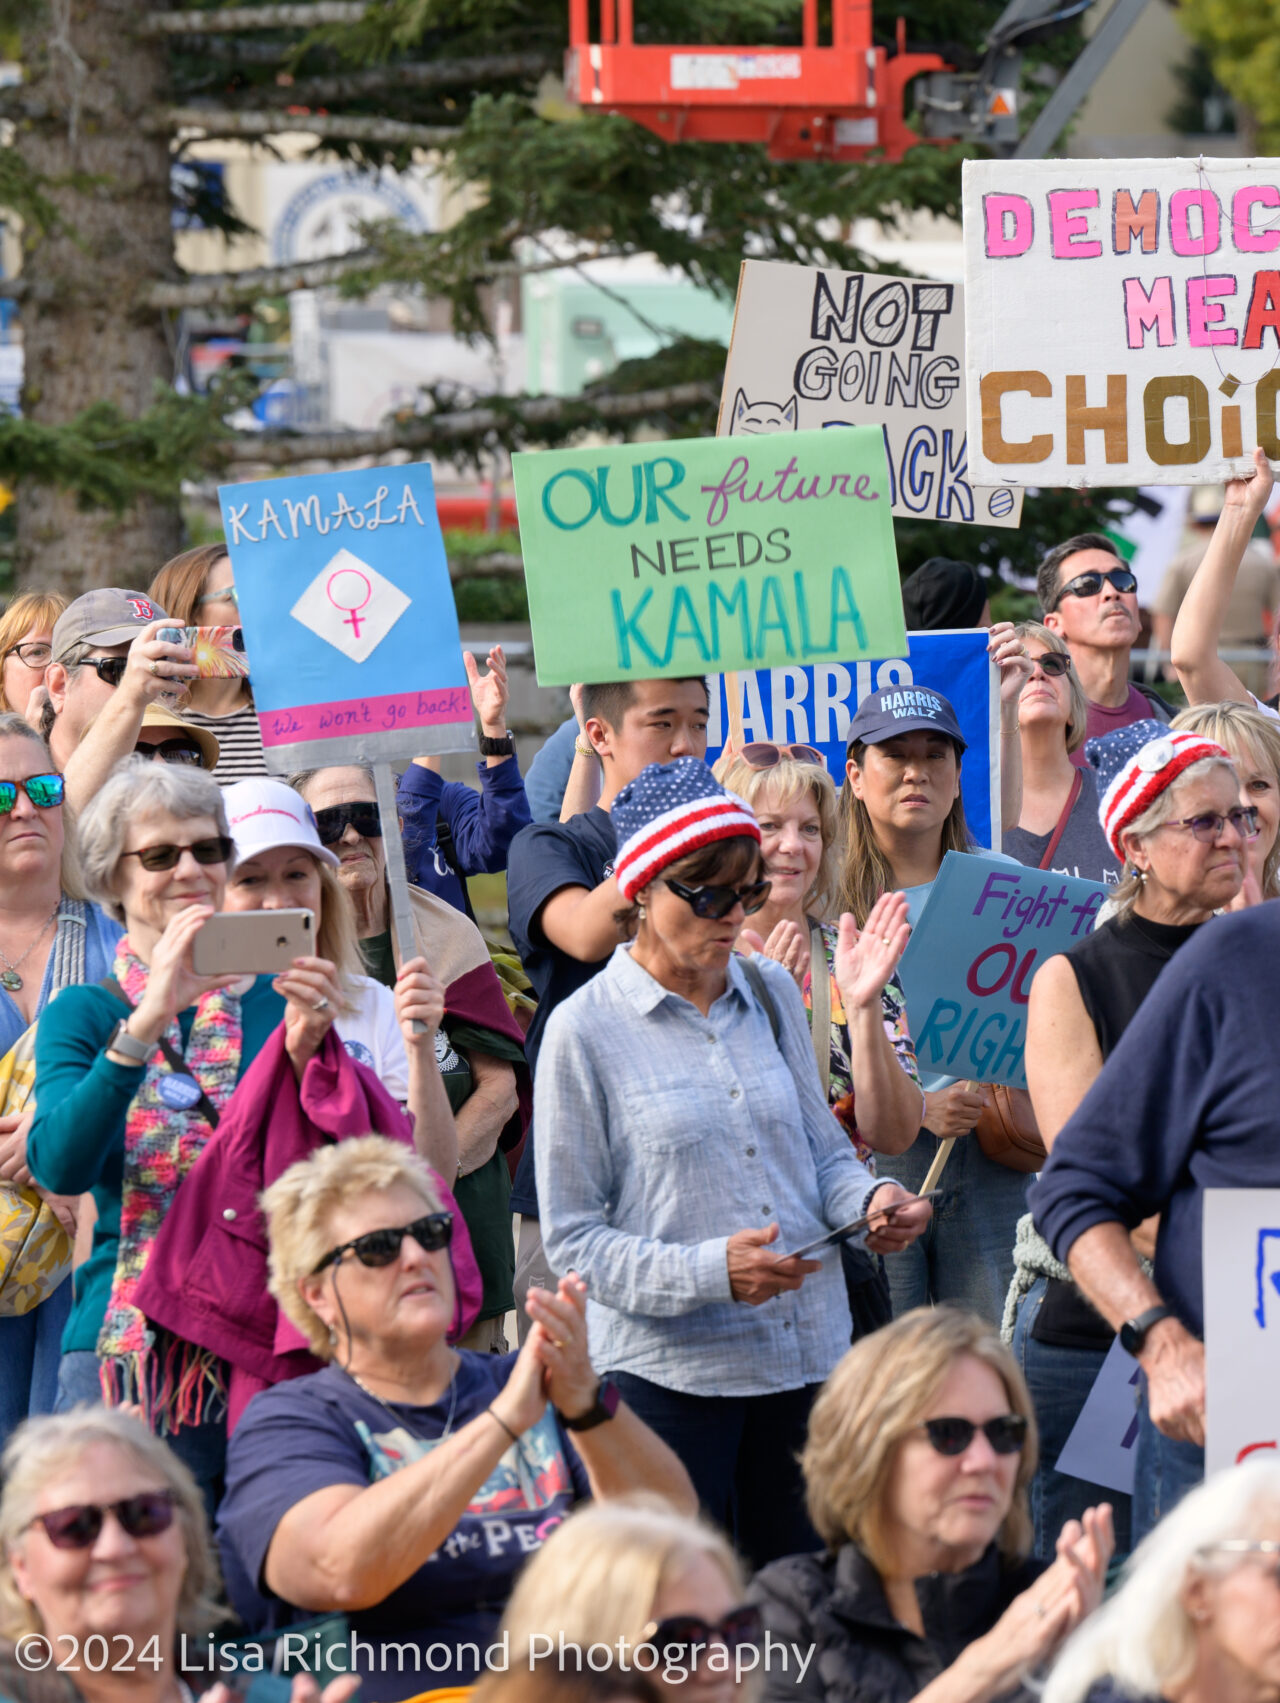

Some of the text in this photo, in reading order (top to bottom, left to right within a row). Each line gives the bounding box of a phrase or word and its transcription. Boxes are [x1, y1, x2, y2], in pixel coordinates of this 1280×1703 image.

[811, 271, 953, 351] NOT
[794, 346, 960, 409] GOING
[228, 484, 424, 545] KAMALA
[541, 456, 880, 531] OUR future
[630, 528, 792, 578] NEEDS
[127, 598, 154, 621] B
[610, 566, 869, 670] KAMALA
[272, 693, 468, 737] We won't go back!
[880, 690, 943, 713] HARRIS
[892, 707, 937, 720] WALZ
[972, 872, 1069, 938] Fight
